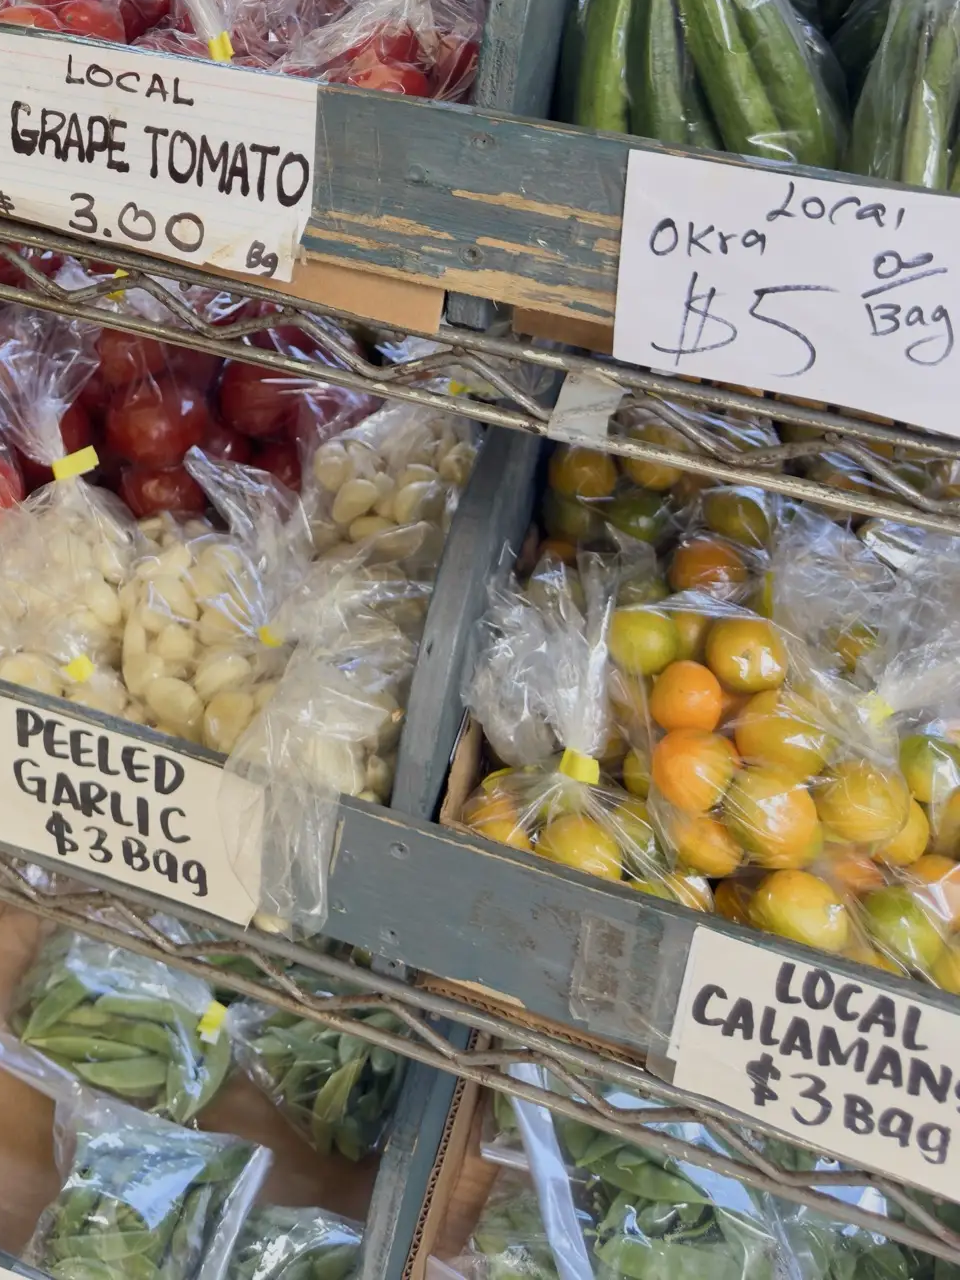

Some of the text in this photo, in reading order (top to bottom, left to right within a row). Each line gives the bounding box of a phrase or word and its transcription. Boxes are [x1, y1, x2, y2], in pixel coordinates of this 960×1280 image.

[65, 54, 195, 107] LOCAL
[10, 100, 311, 208] GRAPE TOMATO
[68, 192, 205, 253] 3.00
[245, 239, 279, 278] Bg
[865, 302, 955, 366] Bag
[15, 707, 186, 796] PEELED
[13, 757, 191, 844] GARLIC
[45, 809, 209, 898] $3 Bag
[691, 983, 960, 1115] CALAMAN
[775, 961, 929, 1051] LOCAL
[745, 1051, 952, 1165] $3 Bag
